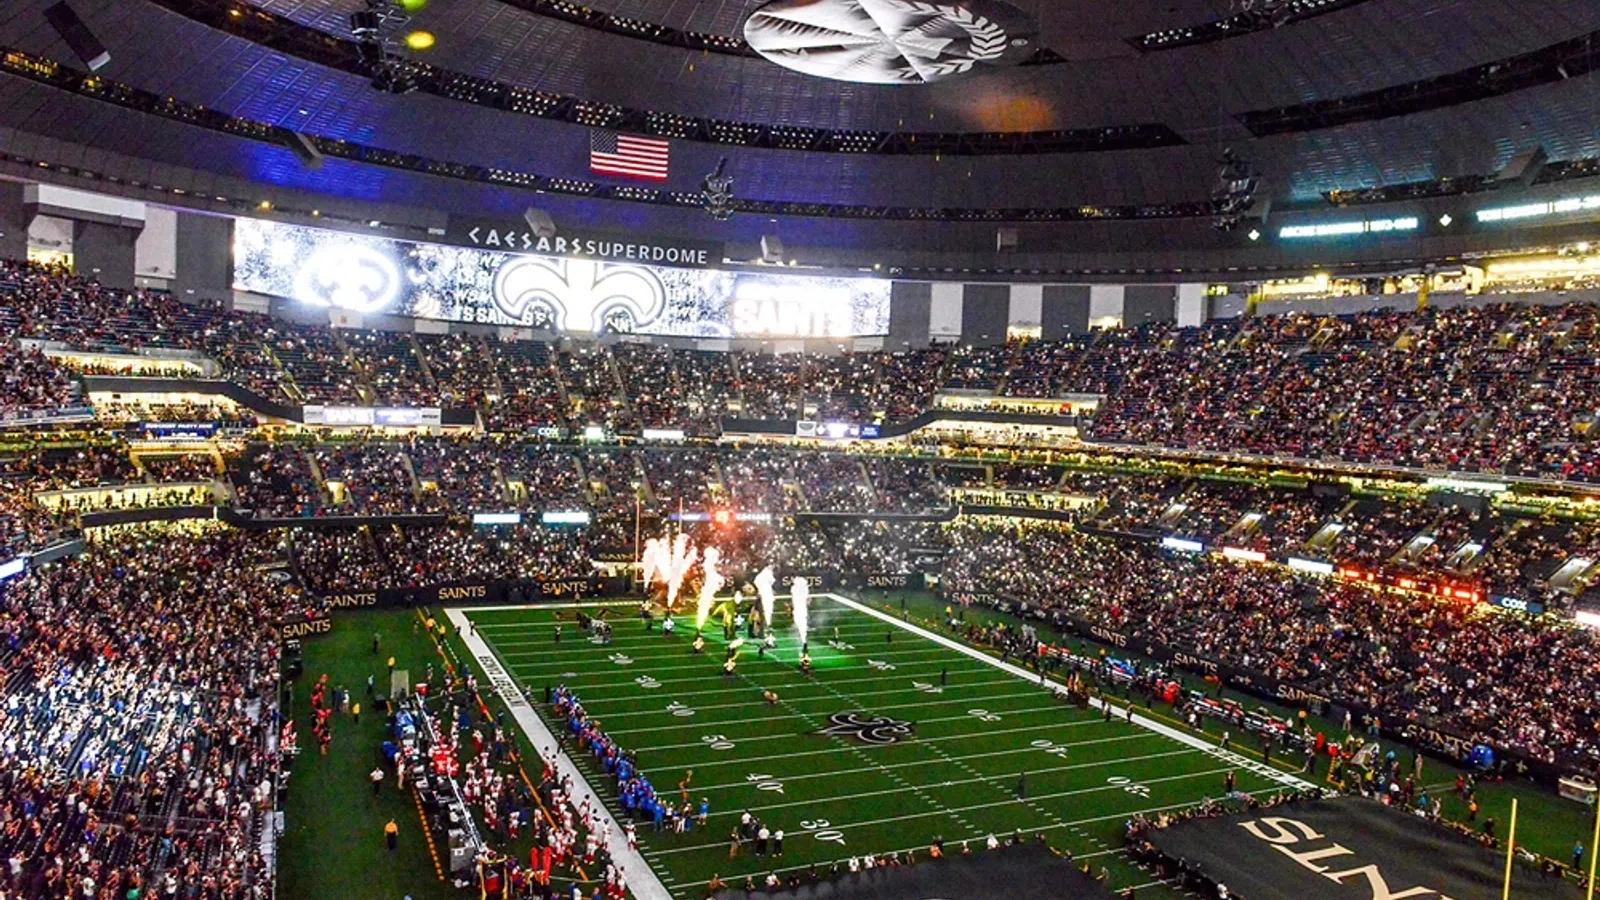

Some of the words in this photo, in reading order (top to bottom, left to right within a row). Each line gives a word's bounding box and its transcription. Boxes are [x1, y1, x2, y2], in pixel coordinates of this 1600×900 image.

[469, 227, 582, 254] CAESARS
[586, 240, 707, 264] SUPERDOME
[538, 427, 559, 437] COX
[542, 581, 588, 594] SAINTS
[782, 576, 822, 587] SATS
[867, 576, 906, 587] SAINTS
[438, 585, 486, 600] SAINTS
[952, 592, 994, 605] SAINTS
[324, 593, 377, 607] SAINTS
[1501, 598, 1528, 611] COX
[282, 619, 331, 639] SAINTS
[800, 818, 844, 841] 30
